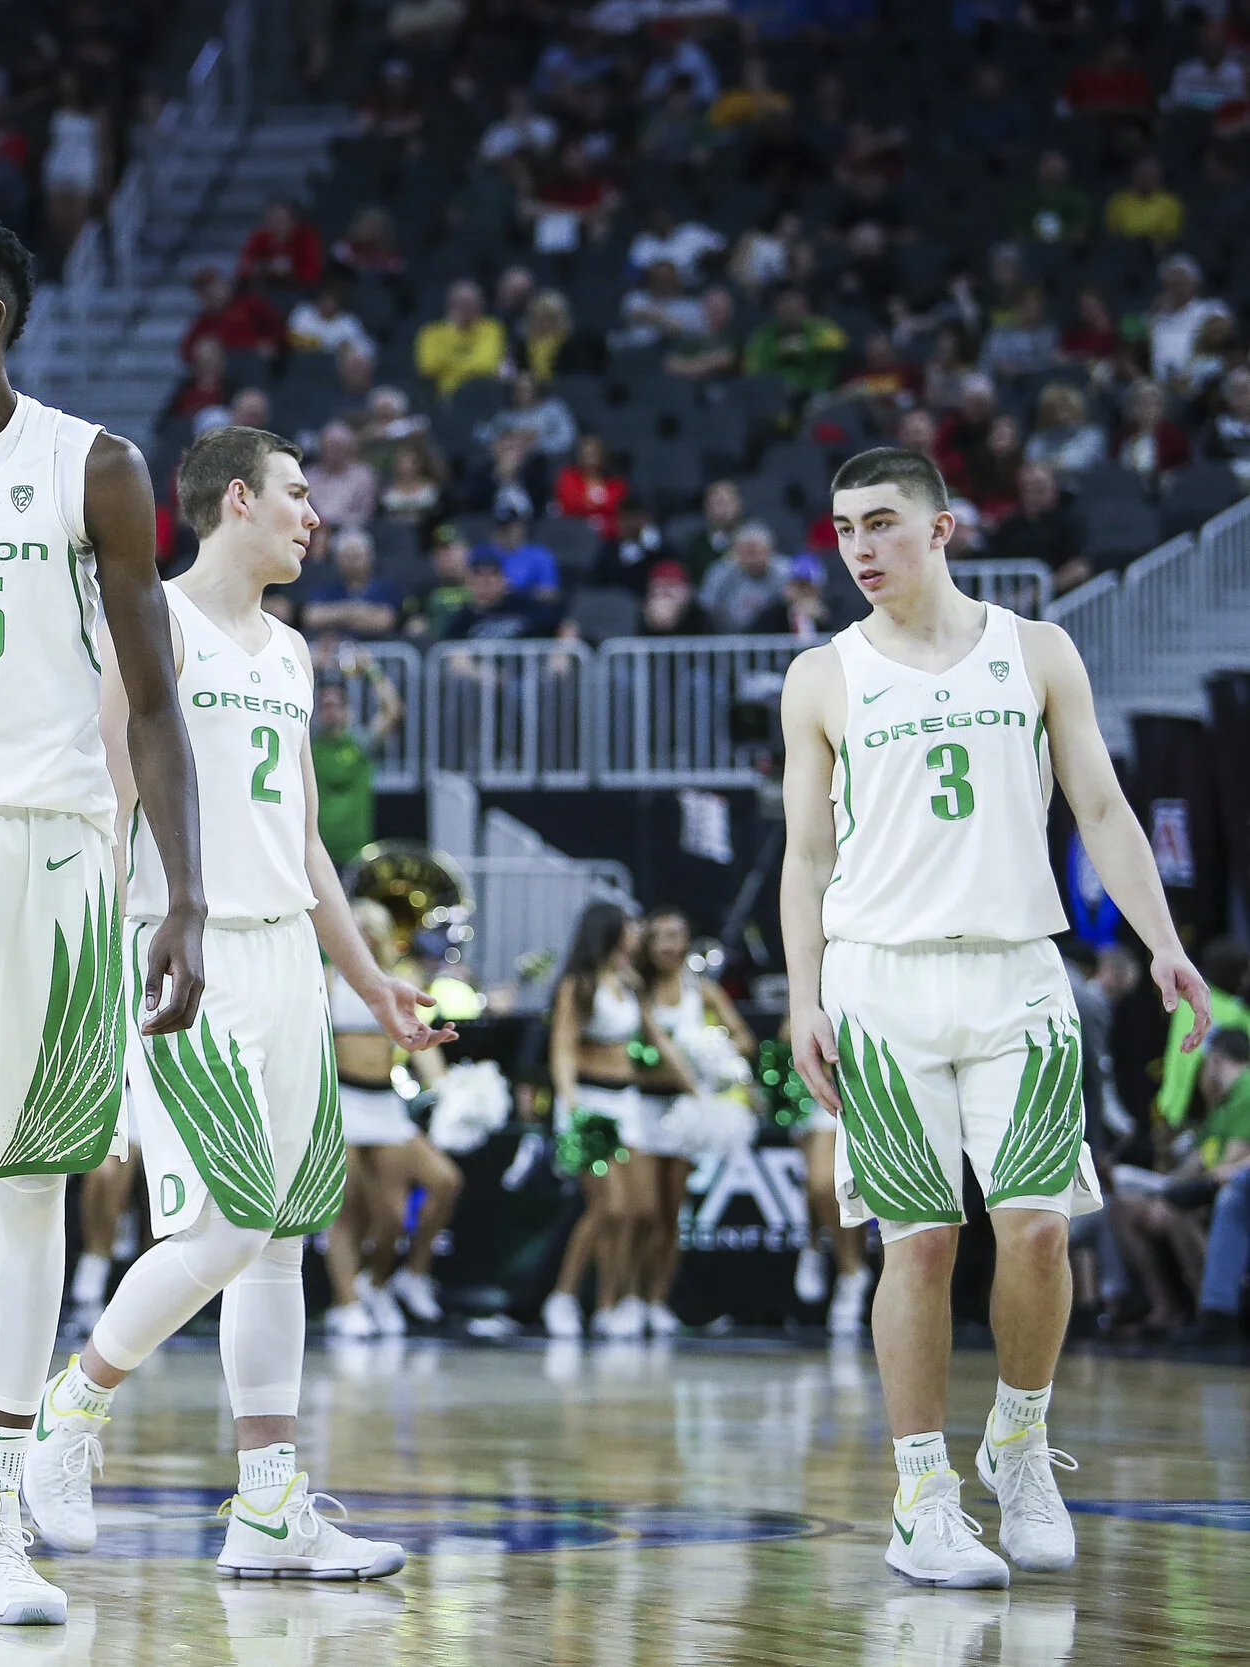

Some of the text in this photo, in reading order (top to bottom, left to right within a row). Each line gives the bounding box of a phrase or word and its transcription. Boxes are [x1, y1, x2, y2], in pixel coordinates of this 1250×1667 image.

[192, 691, 309, 728] OREGON
[935, 689, 950, 703] O
[864, 709, 1027, 749] OREGON
[251, 726, 282, 805] 2
[926, 743, 975, 821] 3
